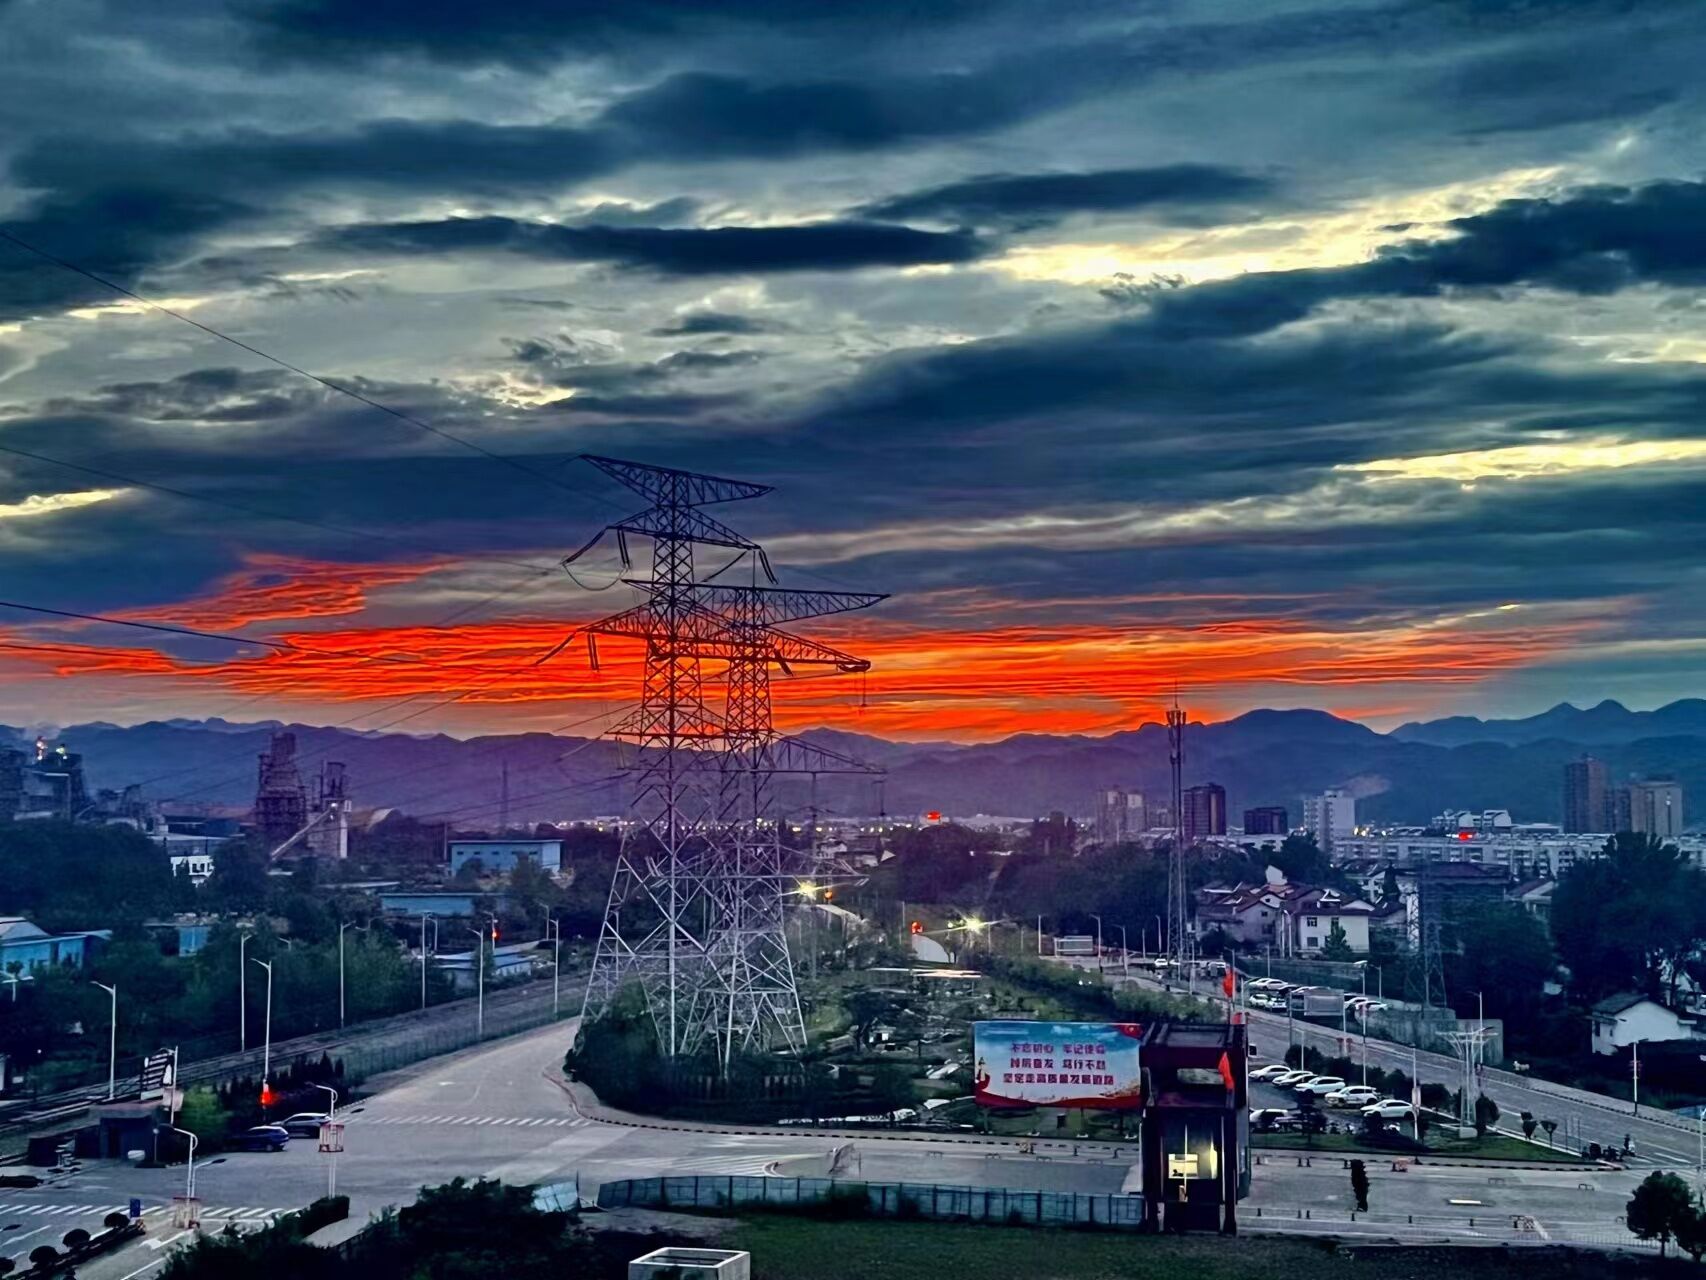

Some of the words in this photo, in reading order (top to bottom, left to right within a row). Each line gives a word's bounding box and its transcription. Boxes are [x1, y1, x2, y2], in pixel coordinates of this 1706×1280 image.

[1011, 1043, 1054, 1054] 不忘初心
[1063, 1044, 1106, 1055] 牢记使命
